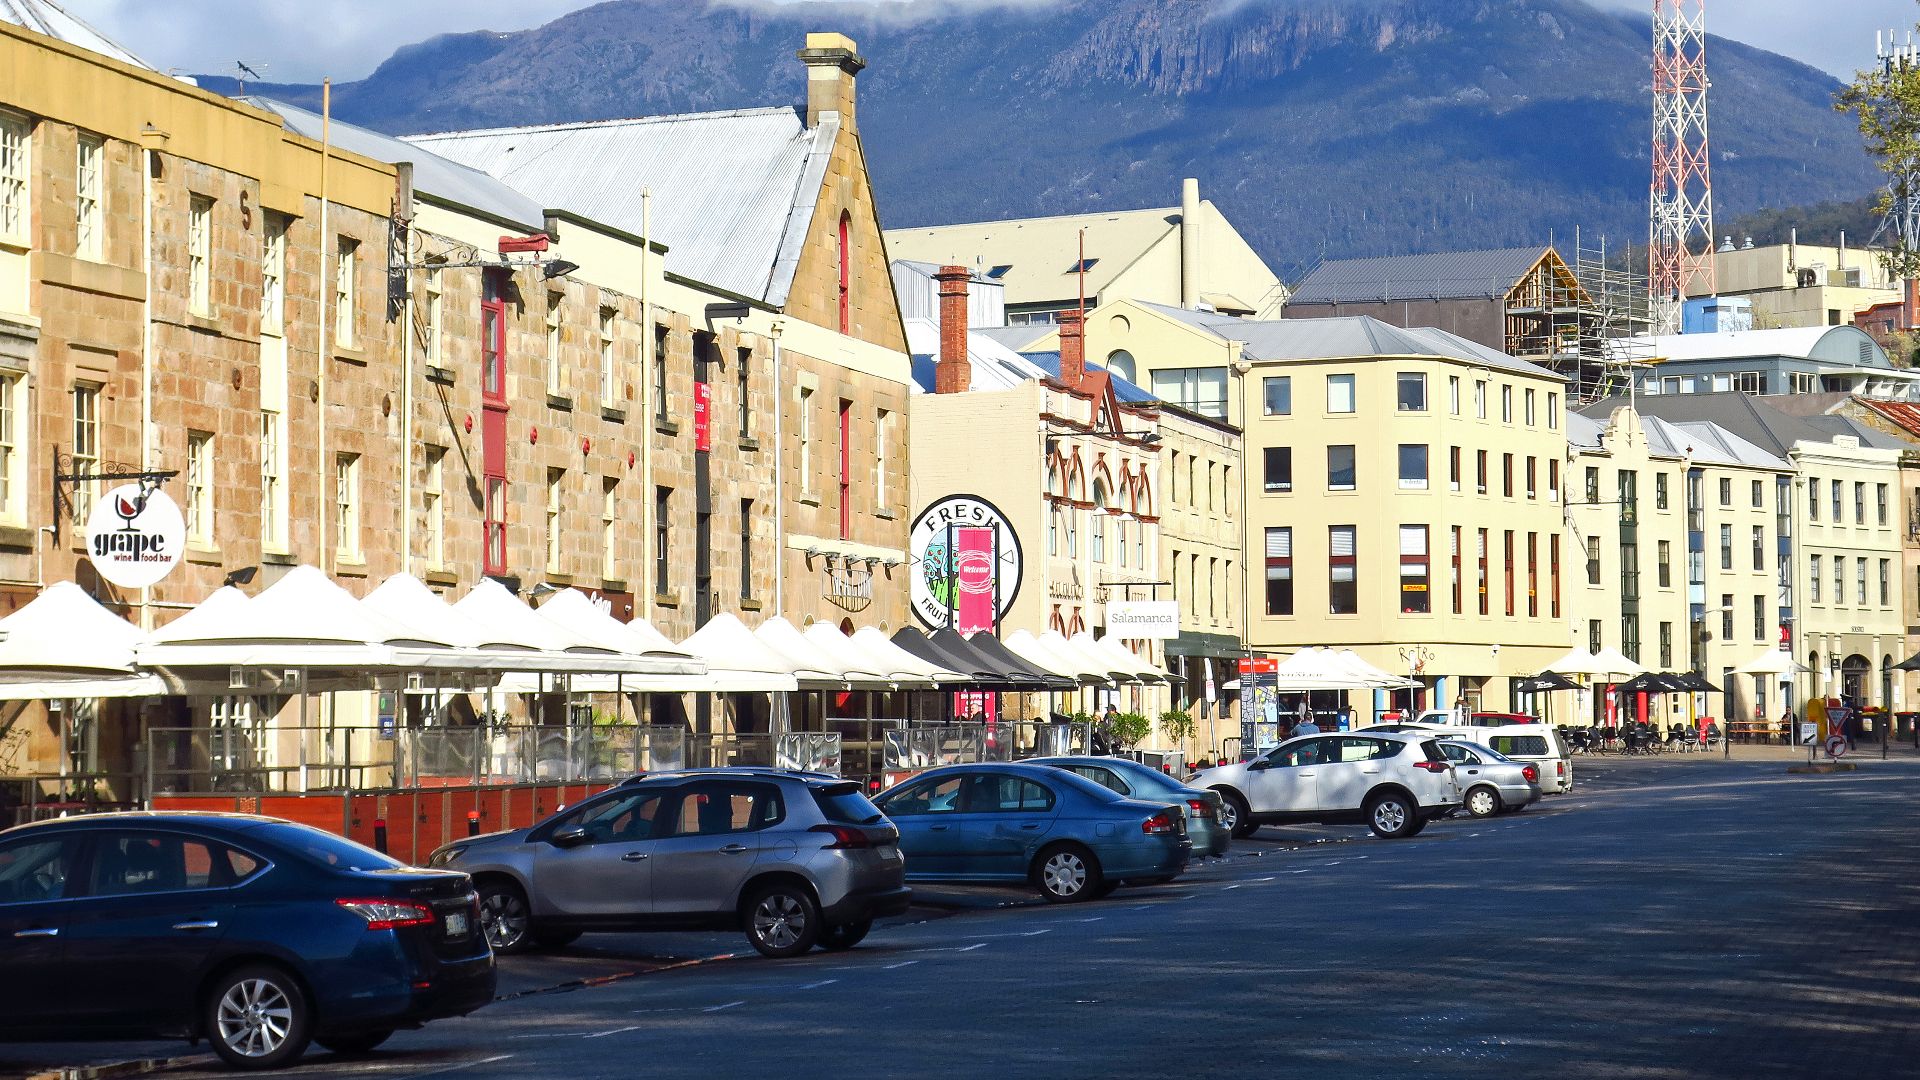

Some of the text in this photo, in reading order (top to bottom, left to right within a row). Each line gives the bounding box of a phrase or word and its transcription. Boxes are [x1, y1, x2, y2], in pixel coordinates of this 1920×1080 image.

[94, 534, 164, 562] grape
[114, 553, 172, 562] wine food bar
[963, 566, 990, 574] Welcome
[1111, 613, 1173, 624] Salamanca
